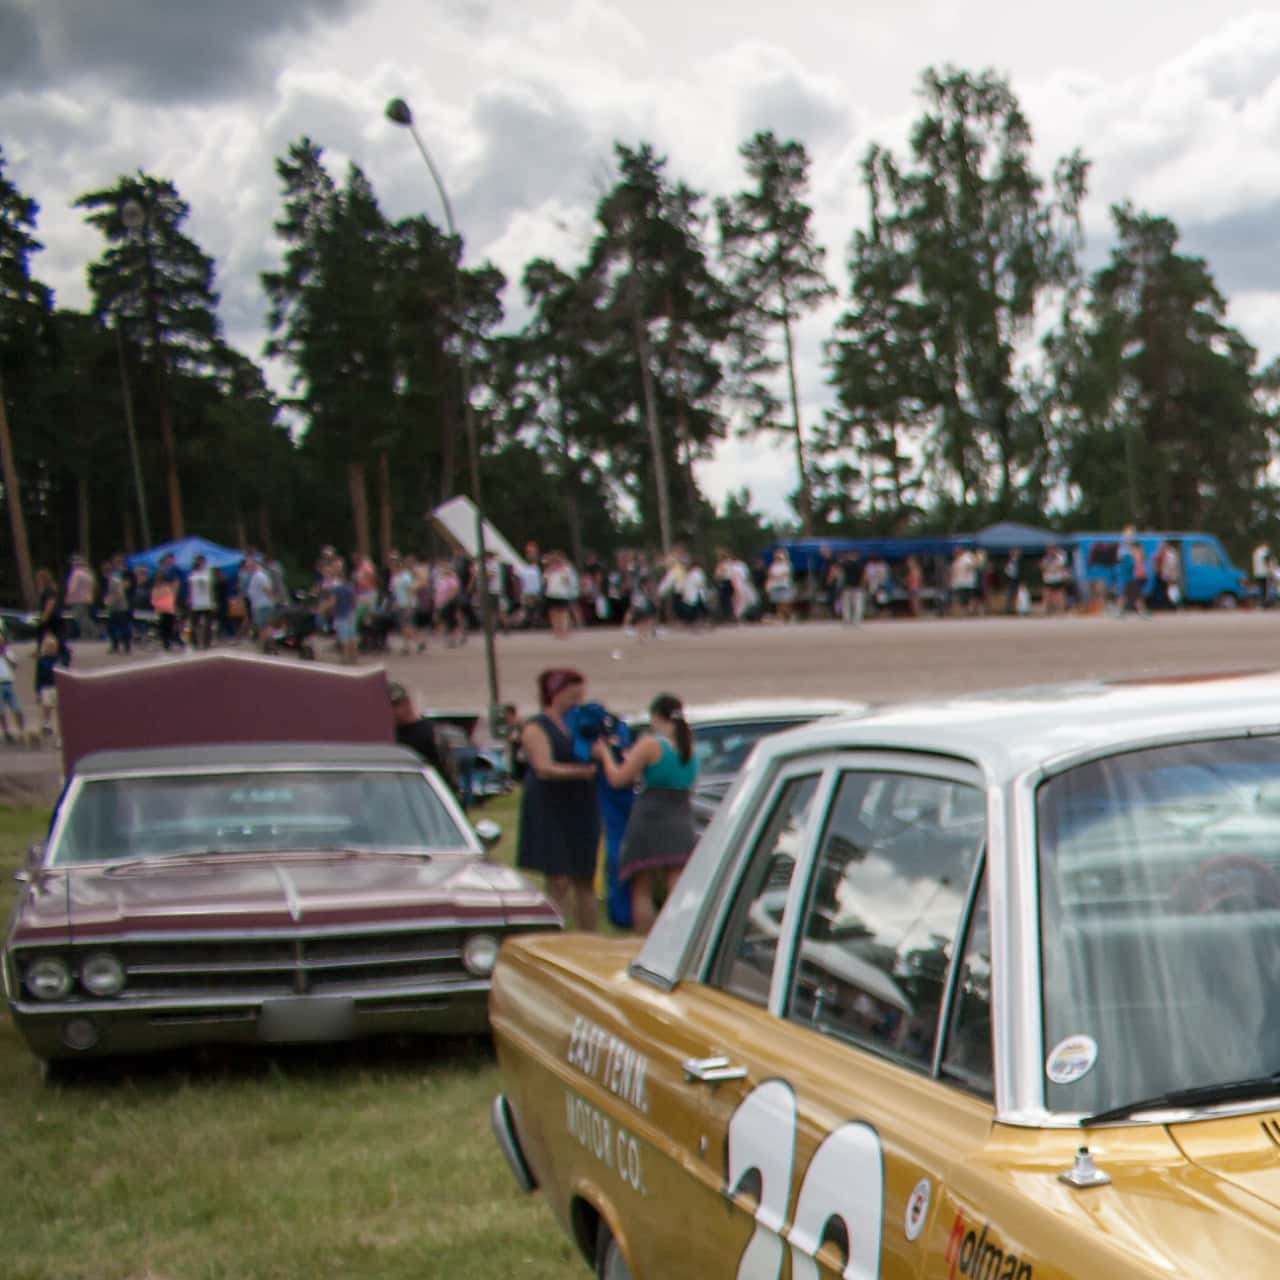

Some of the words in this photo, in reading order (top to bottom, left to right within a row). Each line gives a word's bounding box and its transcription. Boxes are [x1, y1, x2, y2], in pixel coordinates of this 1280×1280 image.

[567, 1015, 609, 1078] EAST
[565, 1088, 613, 1168] MOTOR
[616, 1127, 648, 1197] CO.
